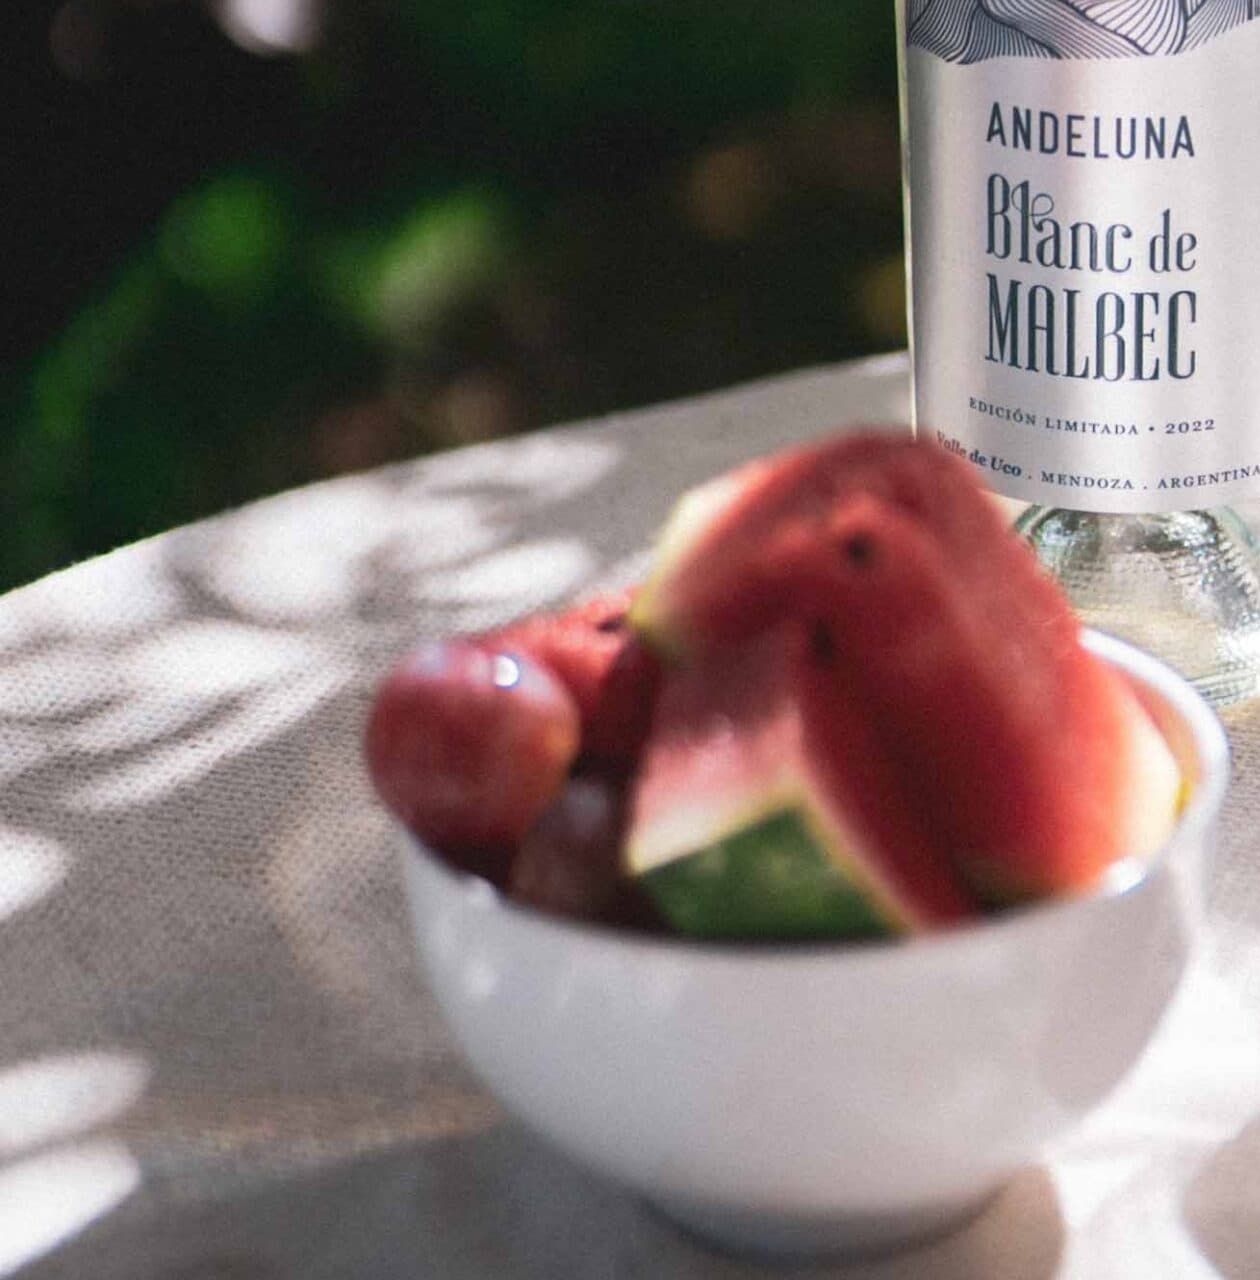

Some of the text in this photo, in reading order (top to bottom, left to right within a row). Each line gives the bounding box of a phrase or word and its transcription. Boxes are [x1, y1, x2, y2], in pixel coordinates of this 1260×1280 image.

[985, 101, 1196, 159] ANDELUNA
[985, 173, 1198, 273] Blanc de
[984, 273, 1197, 382] MALBEC
[968, 397, 1216, 436] EDICIÓN LIMITADA 2022
[969, 449, 988, 467] de
[990, 455, 1022, 477] Uco
[1041, 471, 1134, 490] MENDOZA
